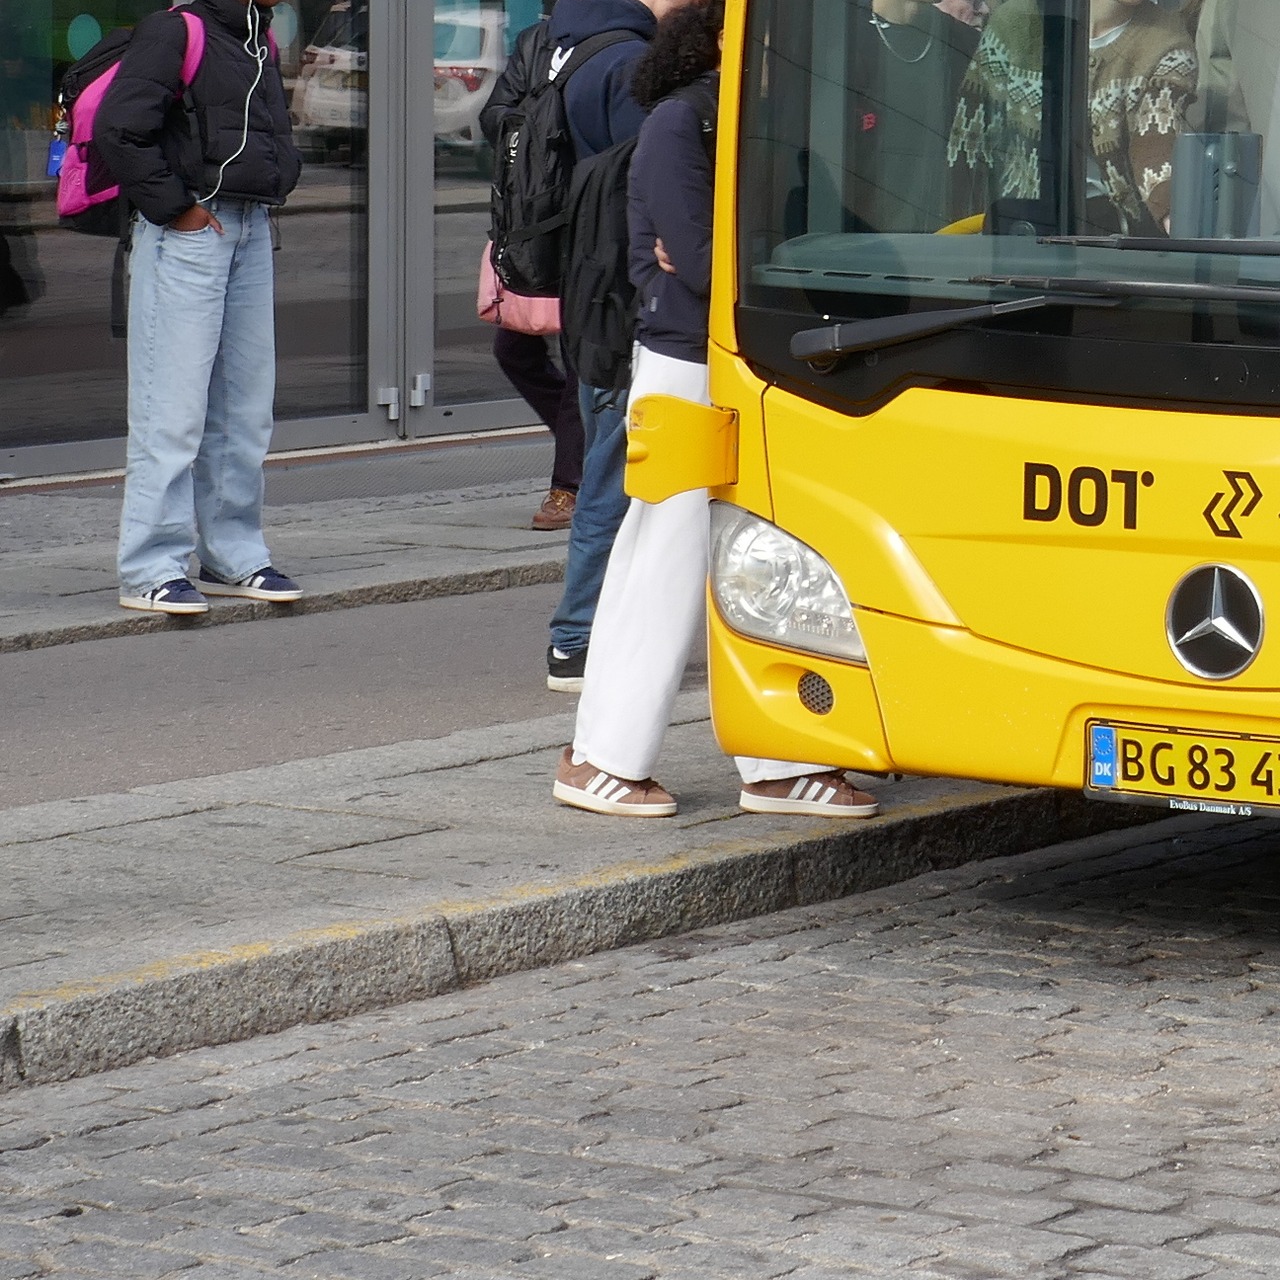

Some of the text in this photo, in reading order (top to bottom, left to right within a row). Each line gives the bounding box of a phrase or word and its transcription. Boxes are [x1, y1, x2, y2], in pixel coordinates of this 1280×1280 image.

[1023, 462, 1150, 530] DOT
[1094, 762, 1112, 777] DK
[1121, 738, 1175, 786] BG
[1187, 744, 1237, 792] 83
[1169, 800, 1252, 816] EvoBus Danmark A/S
